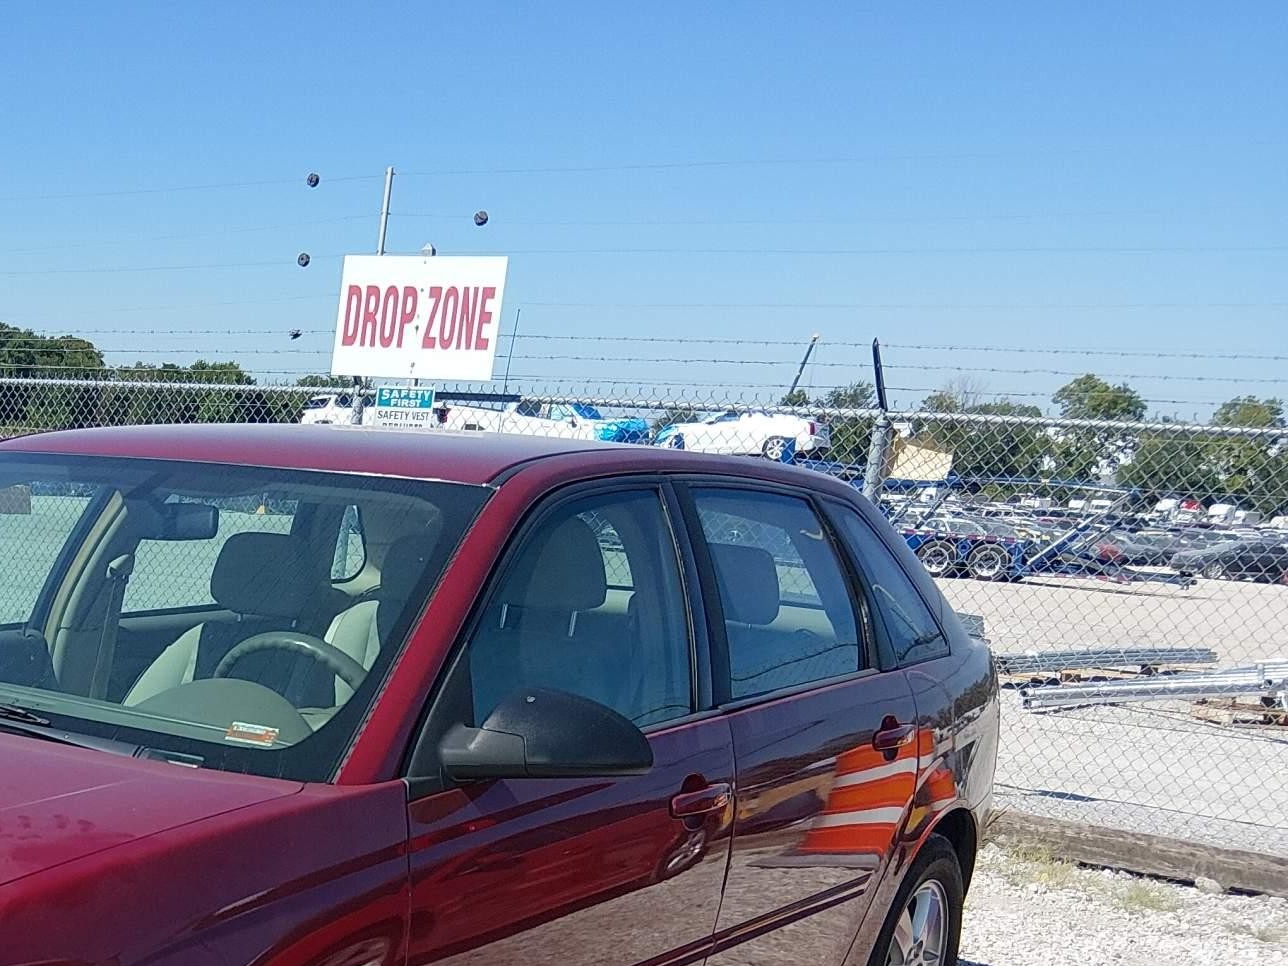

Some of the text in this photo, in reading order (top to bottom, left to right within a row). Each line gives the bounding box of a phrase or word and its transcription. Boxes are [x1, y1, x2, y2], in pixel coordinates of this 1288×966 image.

[341, 284, 497, 351] DROP ZONE
[380, 389, 431, 402] SAFETY
[390, 398, 421, 408] FIRST
[377, 410, 430, 421] SAFETY VEST
